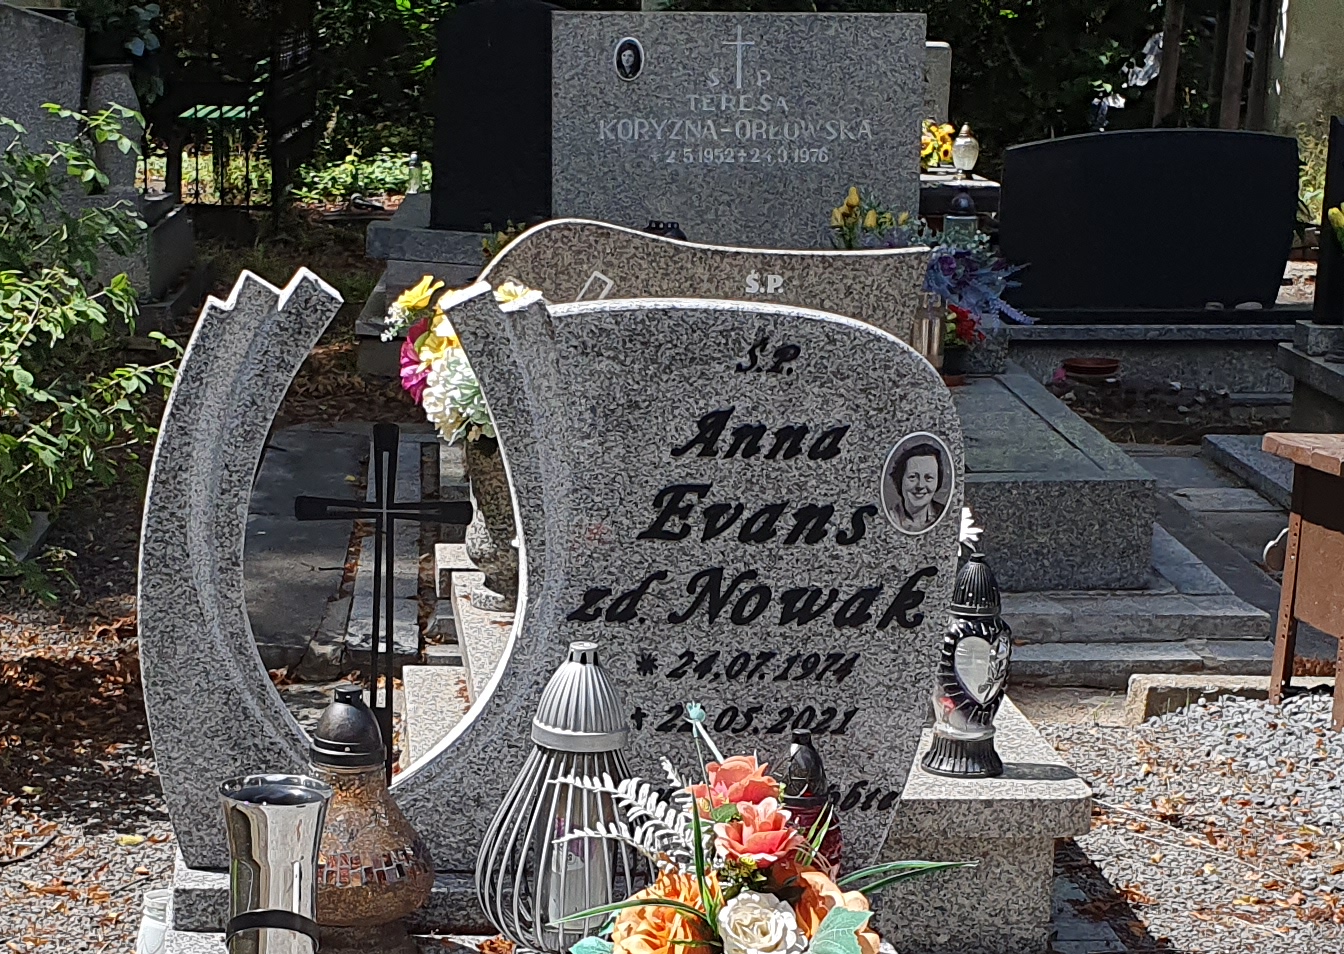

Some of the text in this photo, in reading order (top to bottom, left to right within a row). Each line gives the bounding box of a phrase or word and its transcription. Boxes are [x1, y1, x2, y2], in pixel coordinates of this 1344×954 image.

[686, 94, 789, 112] TERESA
[599, 119, 873, 141] KORYZNA-ORŁOWSKA
[745, 269, 785, 294] Ś.P.
[670, 406, 852, 461] Anna
[636, 482, 879, 546] Evans
[567, 566, 939, 630] zd. Nowak
[665, 650, 861, 683] 24.07.1974
